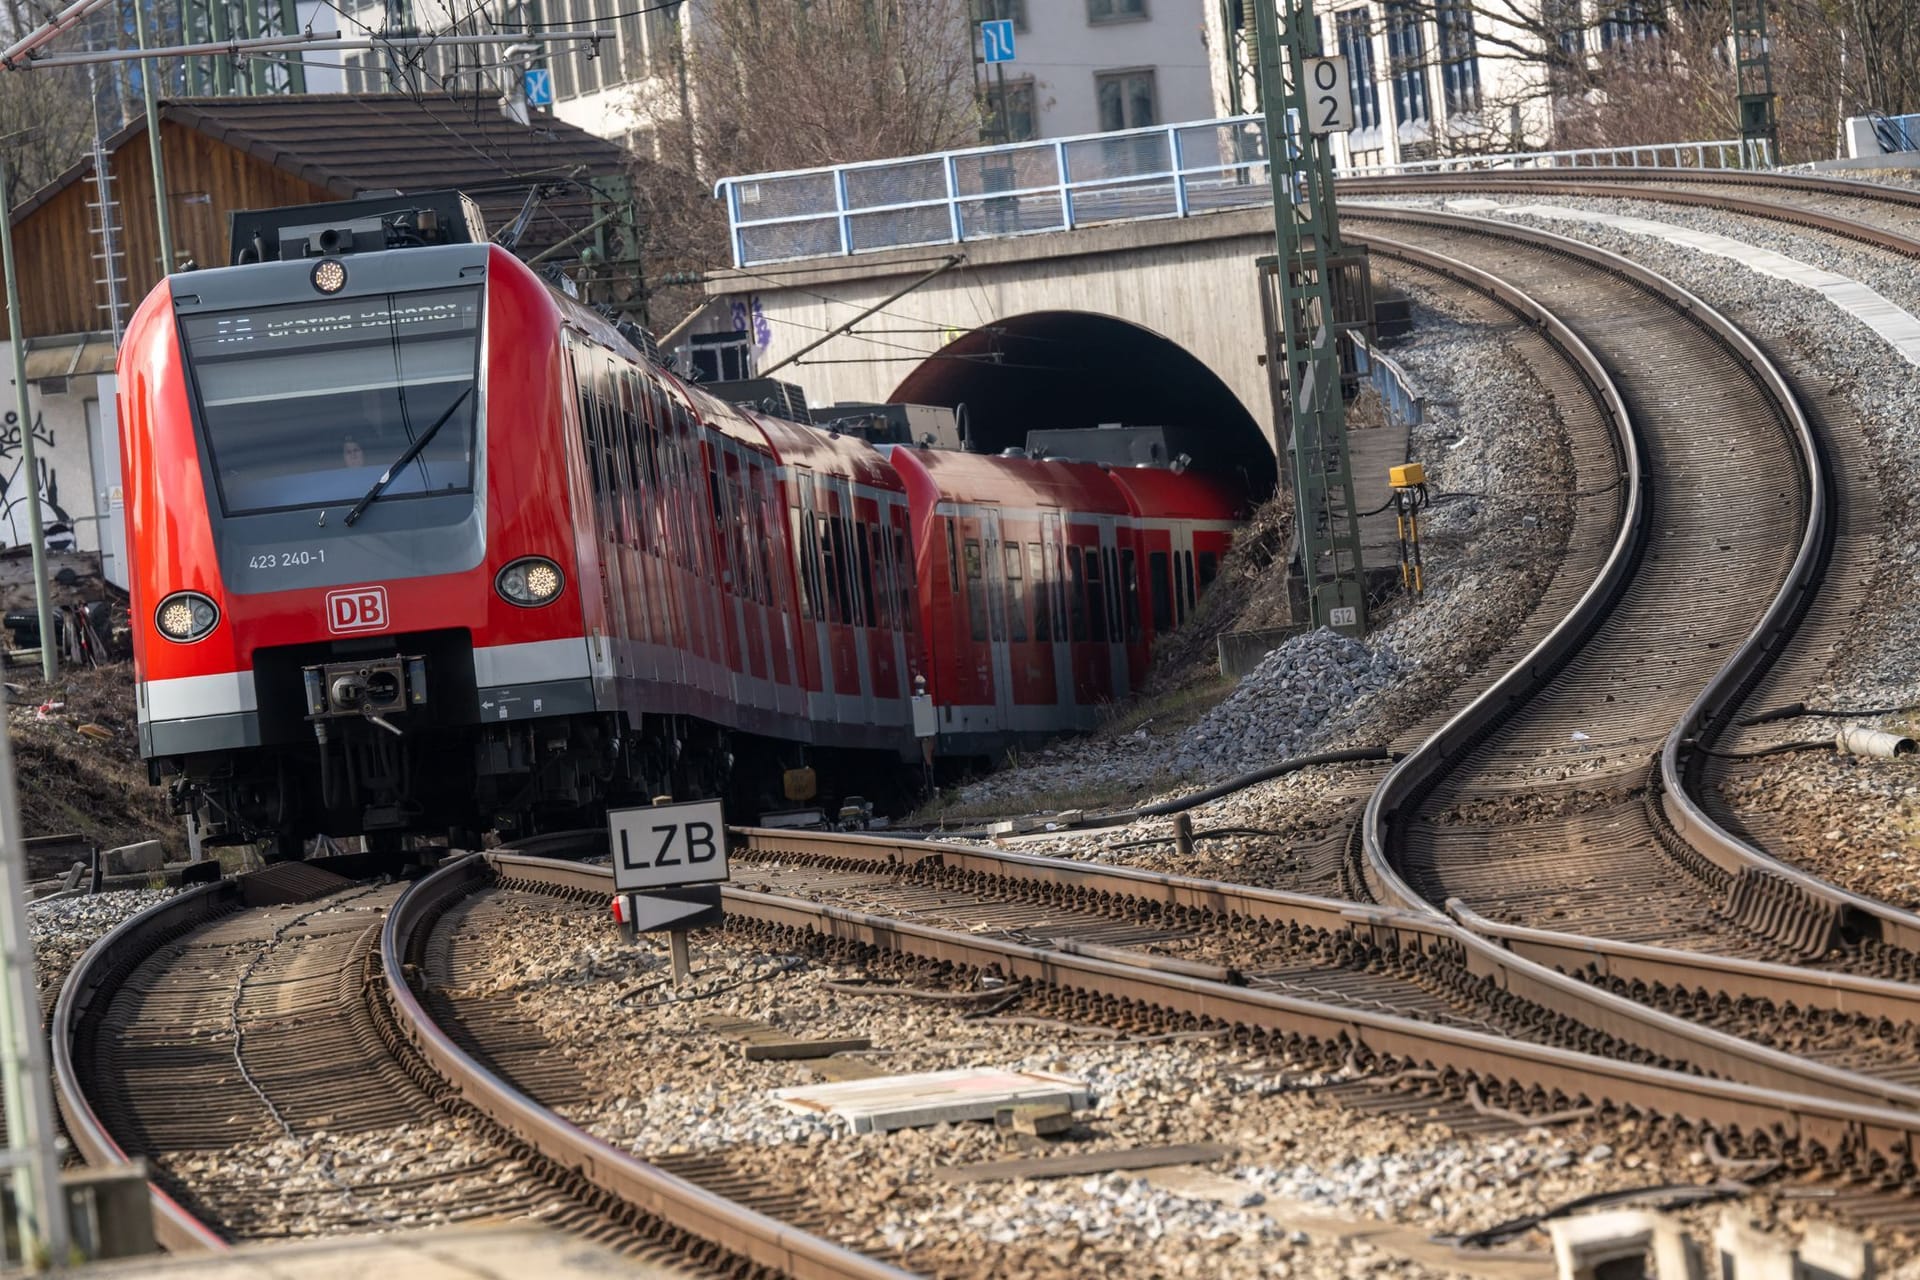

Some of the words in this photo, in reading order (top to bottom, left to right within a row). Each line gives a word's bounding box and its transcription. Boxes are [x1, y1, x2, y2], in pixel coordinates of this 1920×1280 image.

[1314, 60, 1337, 91] 0
[1318, 95, 1340, 127] 2
[249, 555, 277, 569] 423
[281, 549, 325, 567] 240-1
[335, 594, 380, 626] DB
[1333, 609, 1353, 625] 512
[620, 821, 717, 870] LZB
